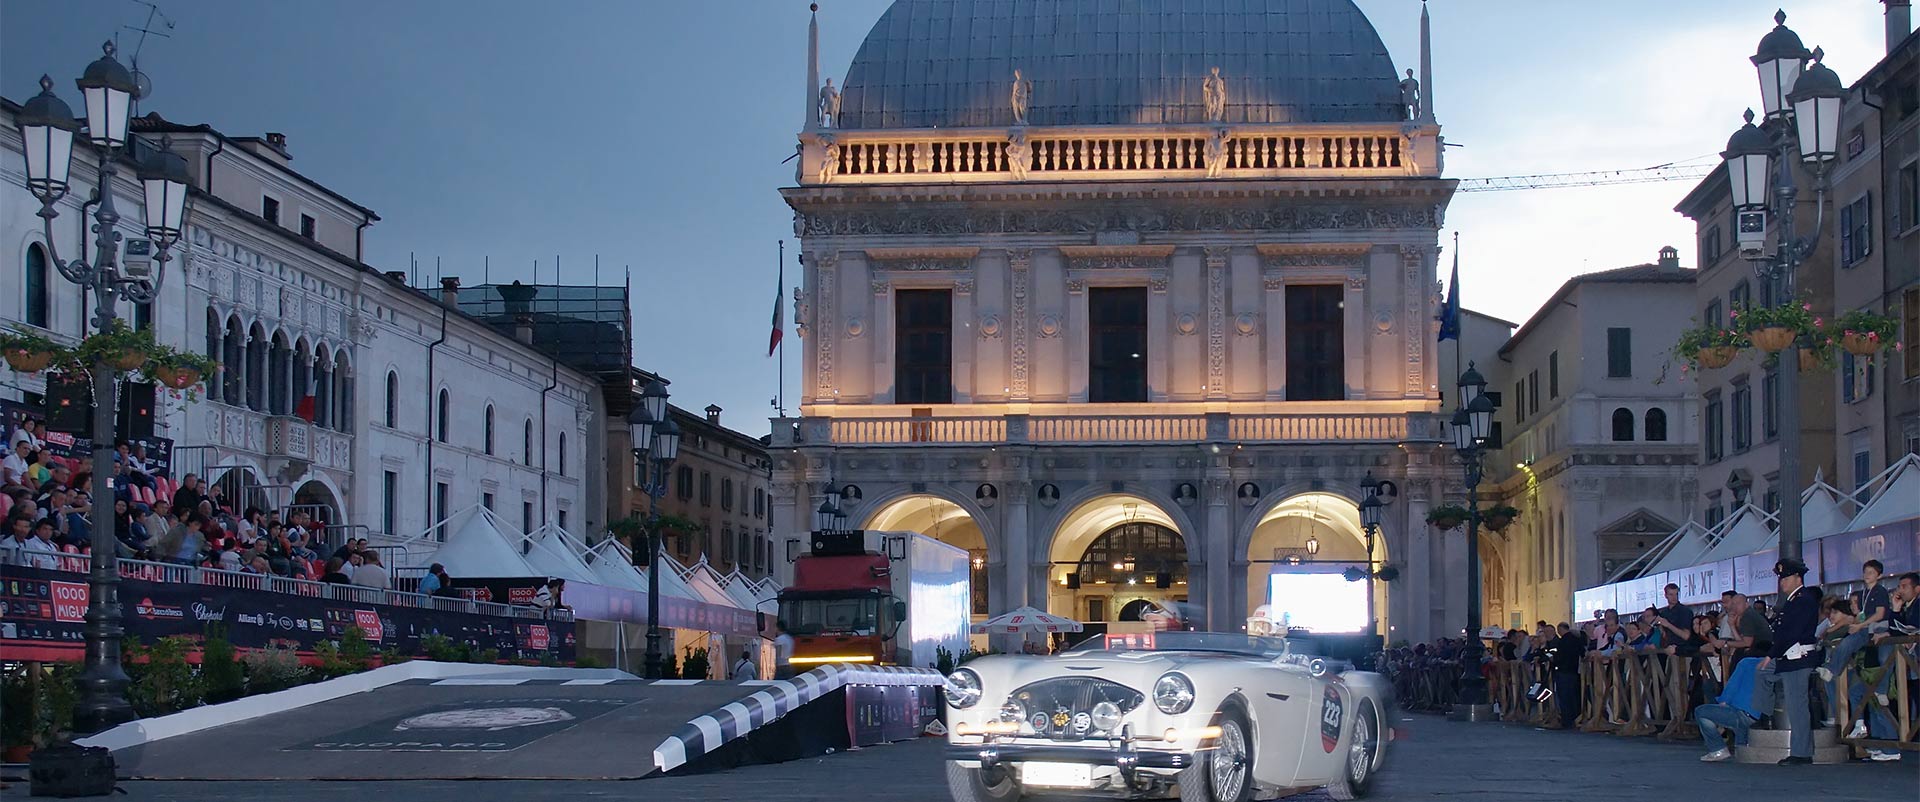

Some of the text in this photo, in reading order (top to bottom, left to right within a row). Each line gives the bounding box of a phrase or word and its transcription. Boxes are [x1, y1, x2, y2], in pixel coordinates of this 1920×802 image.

[57, 587, 86, 601] 1000
[191, 602, 226, 624] Chopard
[238, 613, 257, 624] Allianz
[358, 613, 376, 624] 1000
[1324, 699, 1341, 728] 223
